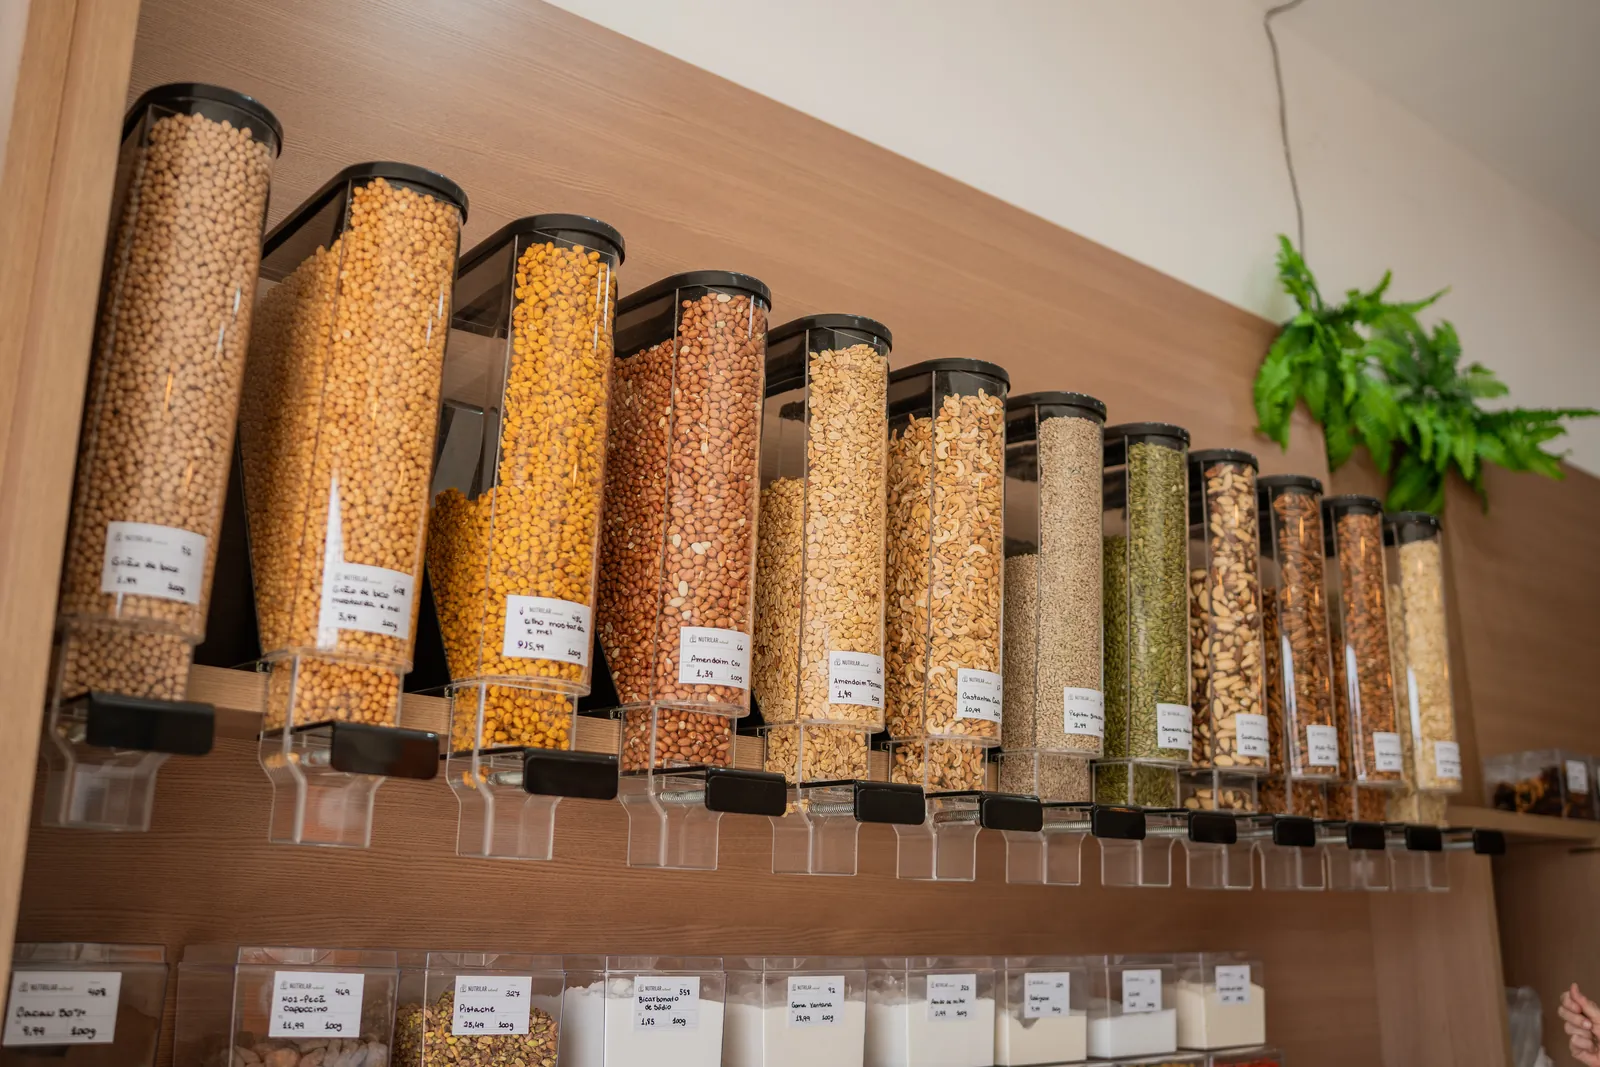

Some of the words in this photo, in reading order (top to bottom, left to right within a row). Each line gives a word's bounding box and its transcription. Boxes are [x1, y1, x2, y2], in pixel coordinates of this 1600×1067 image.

[549, 620, 585, 633] mostarda
[698, 636, 719, 644] NUTRILAR
[690, 655, 729, 665] Amendoim
[696, 669, 713, 678] 1,39
[730, 674, 743, 683] 100g
[834, 678, 866, 686] Amendoim
[962, 691, 991, 703] Castanha
[459, 1003, 495, 1013] Pistache
[672, 1017, 686, 1026] 100g
[821, 1014, 834, 1022] 100g
[324, 1021, 342, 1032] 100g
[498, 1021, 514, 1031] 100g
